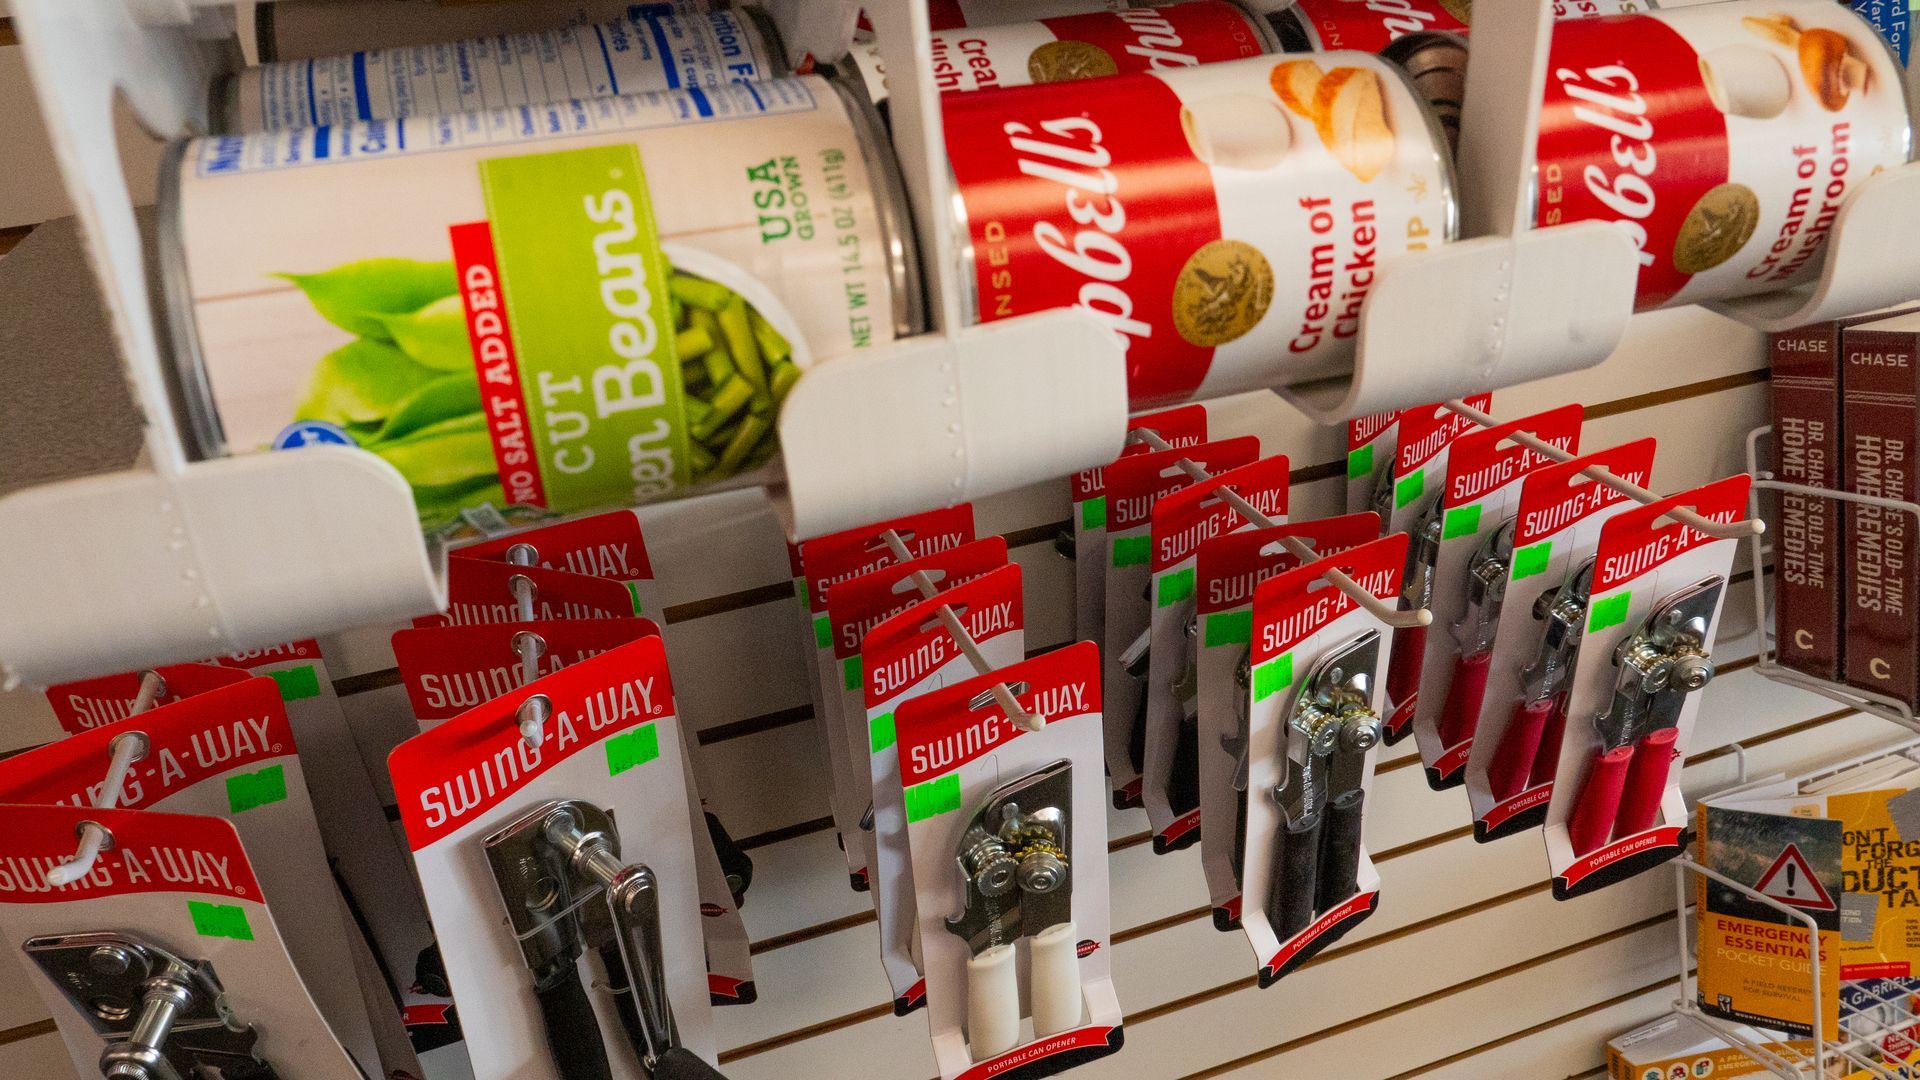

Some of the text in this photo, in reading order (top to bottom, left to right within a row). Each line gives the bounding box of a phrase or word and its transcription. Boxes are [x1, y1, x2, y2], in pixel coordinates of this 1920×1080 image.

[958, 38, 999, 85] Crea
[747, 159, 792, 245] USA
[781, 156, 815, 241] GROWN
[832, 206, 855, 230] OZ
[1746, 144, 1818, 281] Cream of
[1764, 121, 1851, 284] Mushroom
[838, 234, 861, 277] 14.5
[1289, 196, 1335, 354] Cream of
[1332, 200, 1376, 341] Chicken
[584, 188, 666, 419] Beans
[845, 280, 868, 311] WT
[848, 313, 871, 349] NET
[1777, 339, 1828, 353] CHASE
[465, 265, 538, 502] NO SALT ADDED
[1850, 352, 1909, 368] CHASE
[537, 372, 595, 475] CUT
[1856, 434, 1881, 498] HOME
[1160, 488, 1281, 562] SWING-AWAY
[1782, 417, 1806, 585] HOME EMEDIES
[1807, 420, 1825, 589] DR. CHAS'S OLD-TIME
[1884, 439, 1905, 616] DR. CHAE'S OLD-TIME
[1262, 568, 1395, 653] SWING-AWAY
[872, 601, 1012, 696] SWING--WAY
[911, 682, 1086, 775] SWING--WAY
[1508, 794, 1537, 813] PORTABLE
[1589, 835, 1658, 867] PORTABLE CAN OPENER
[1842, 828, 1889, 846] ON'T
[1855, 840, 1920, 861] FORG
[1865, 858, 1892, 869] THE
[1882, 888, 1920, 908] TA
[1292, 926, 1320, 950] PORTABLE
[1717, 947, 1775, 967] POCKET
[1777, 984, 1826, 998] REFERENE
[987, 1036, 1076, 1073] PORTABLE CAN OPENER
